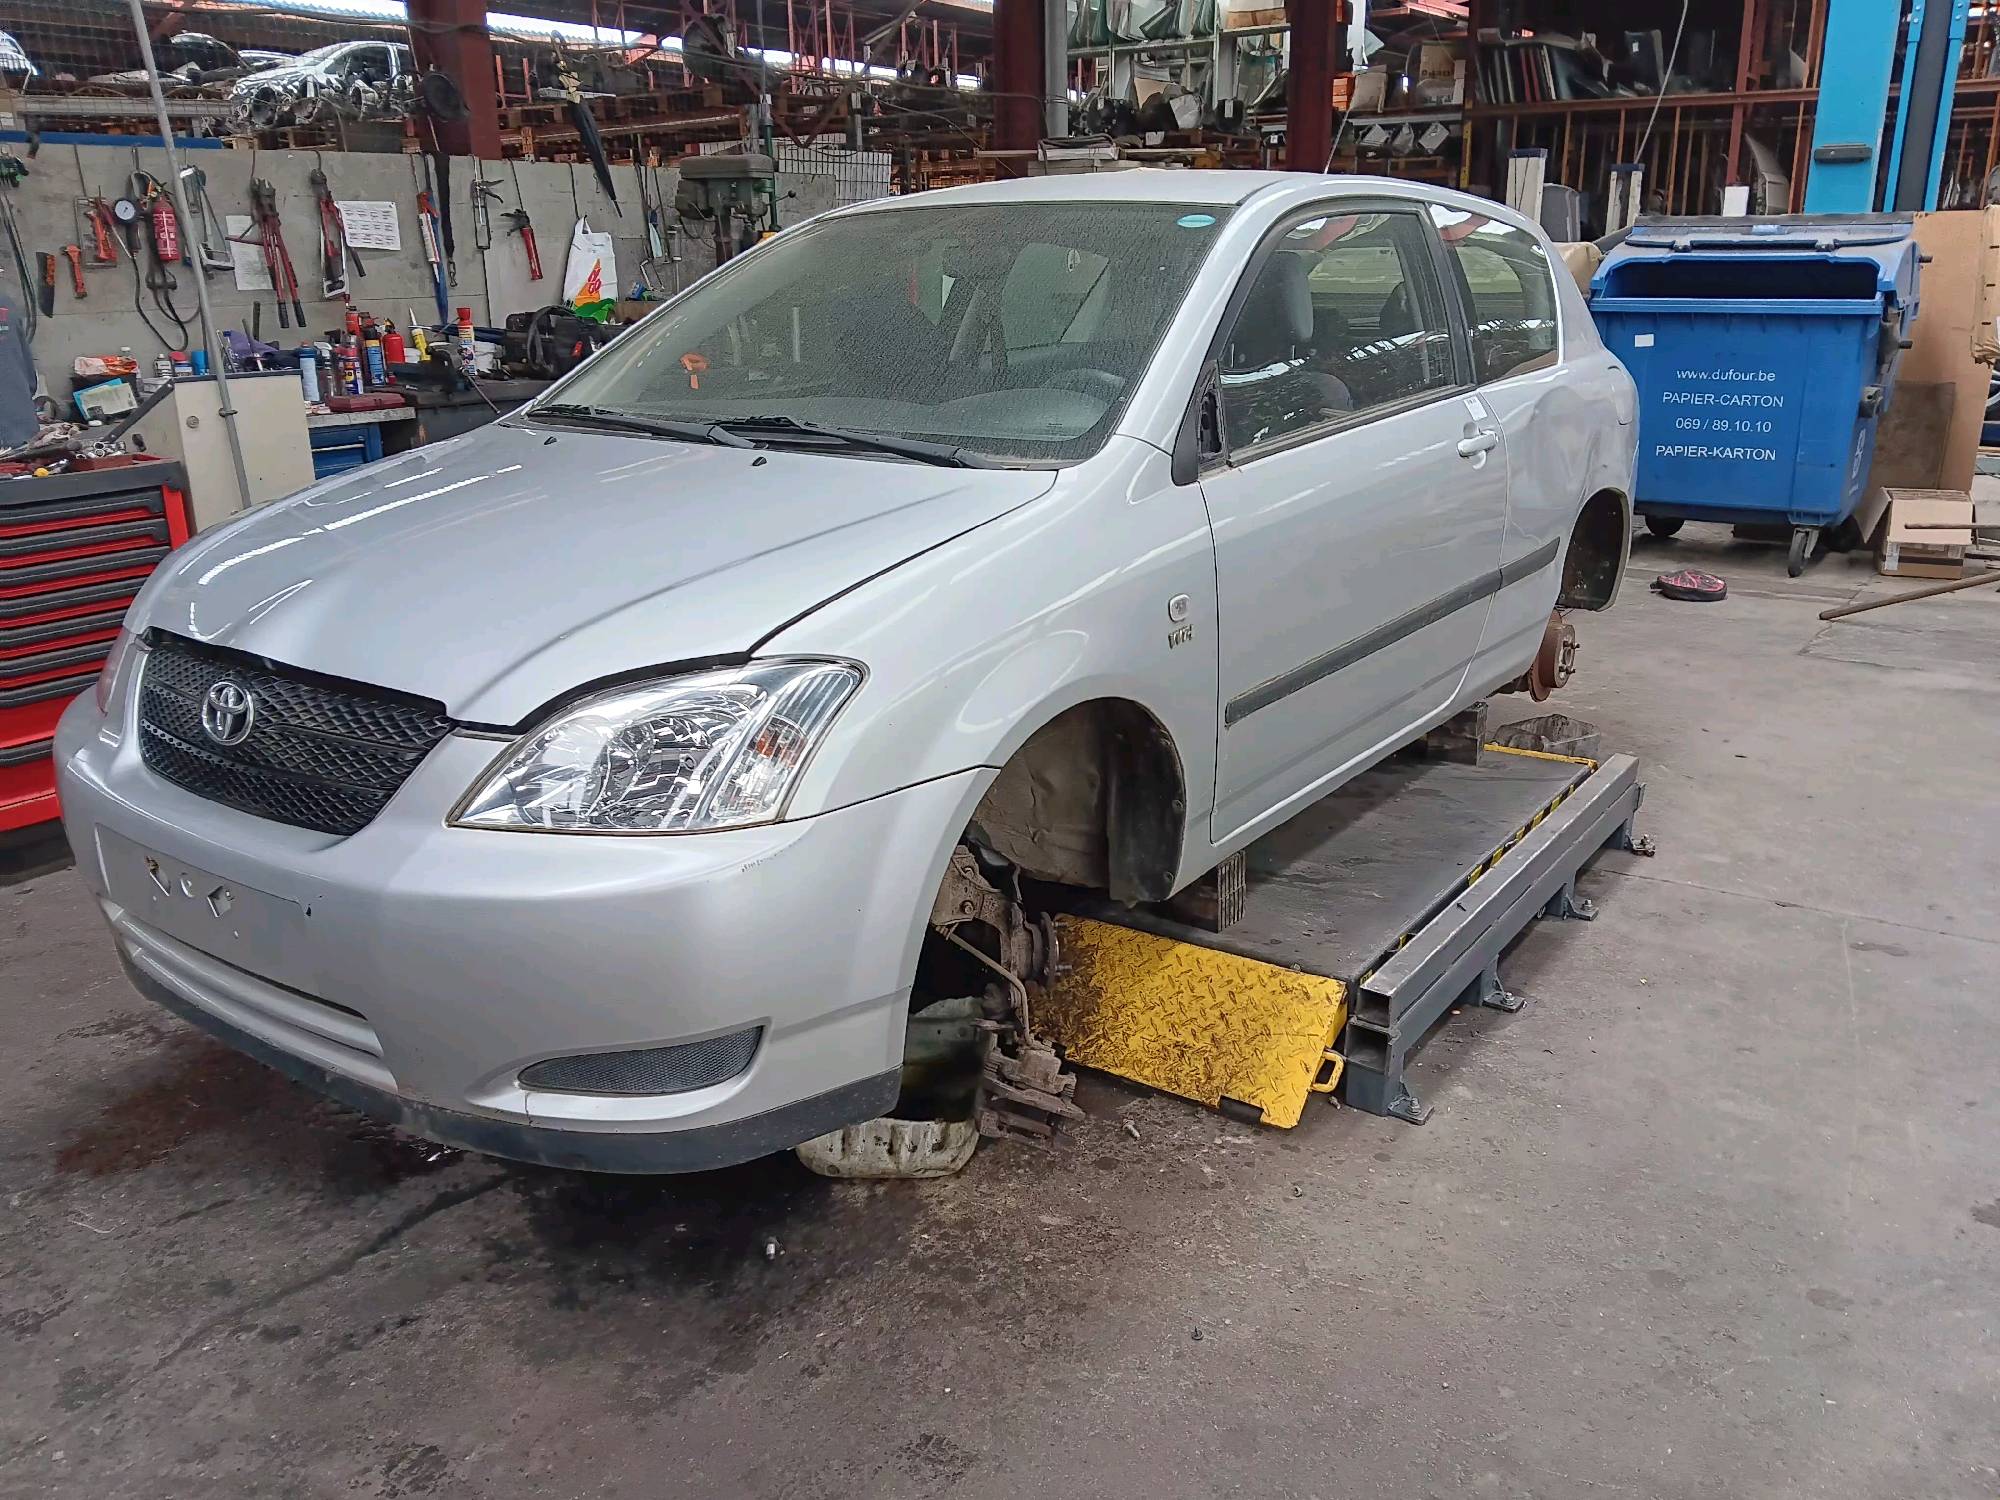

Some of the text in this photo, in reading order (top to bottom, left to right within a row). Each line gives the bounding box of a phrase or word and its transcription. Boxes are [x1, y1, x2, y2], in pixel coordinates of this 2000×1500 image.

[1676, 369, 1776, 382] www.dufour.be
[1662, 392, 1784, 408] PAPIER-CARTON
[1675, 417, 1701, 430] 069
[1711, 419, 1773, 433] 89.10.10
[1655, 445, 1777, 461] PAPIER-KARTON
